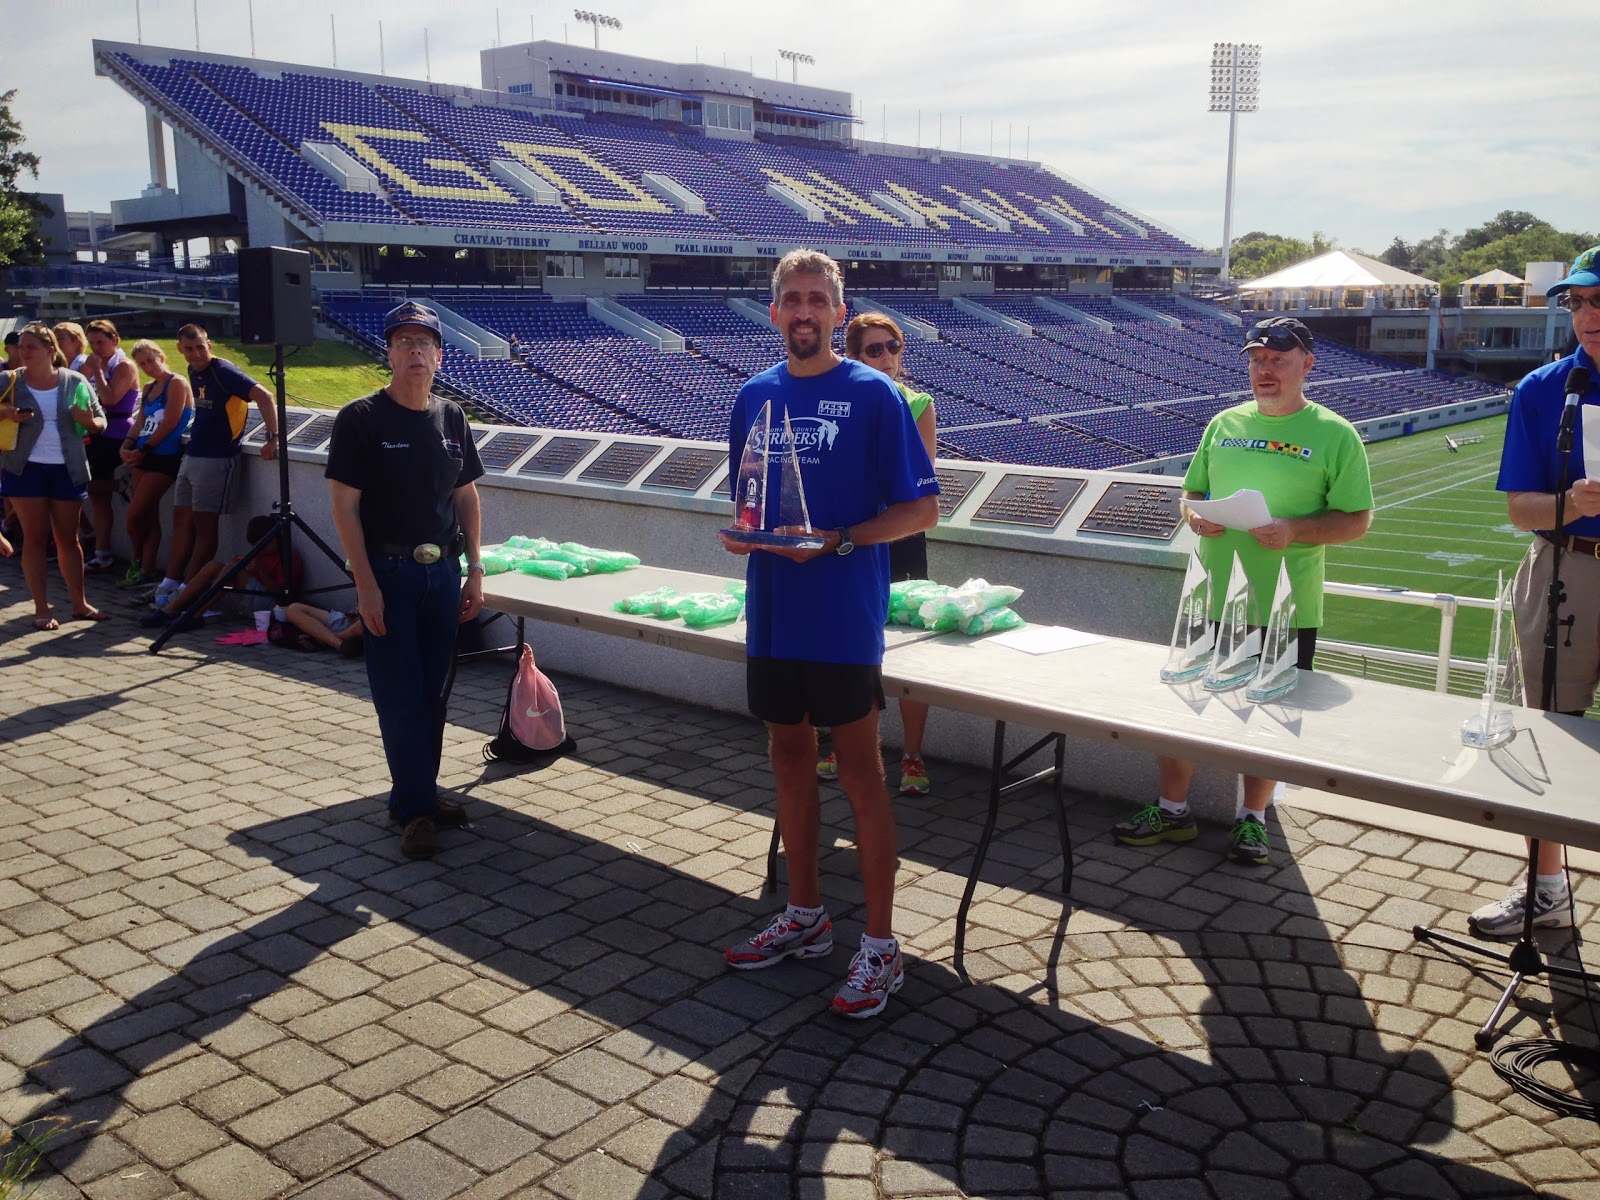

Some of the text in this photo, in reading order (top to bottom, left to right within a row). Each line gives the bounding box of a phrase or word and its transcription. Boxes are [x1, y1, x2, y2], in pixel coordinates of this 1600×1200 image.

[319, 121, 1122, 240] GO NAVY
[454, 234, 550, 248] CHATEAU-THIERRY
[578, 239, 648, 251] BELLEAU WOOD
[674, 243, 734, 254] PEARL HARBOR
[756, 246, 777, 256] WAKE
[847, 249, 882, 259] CORAL SEA
[900, 252, 932, 260] ALEUTIANS
[821, 402, 847, 410] FEET
